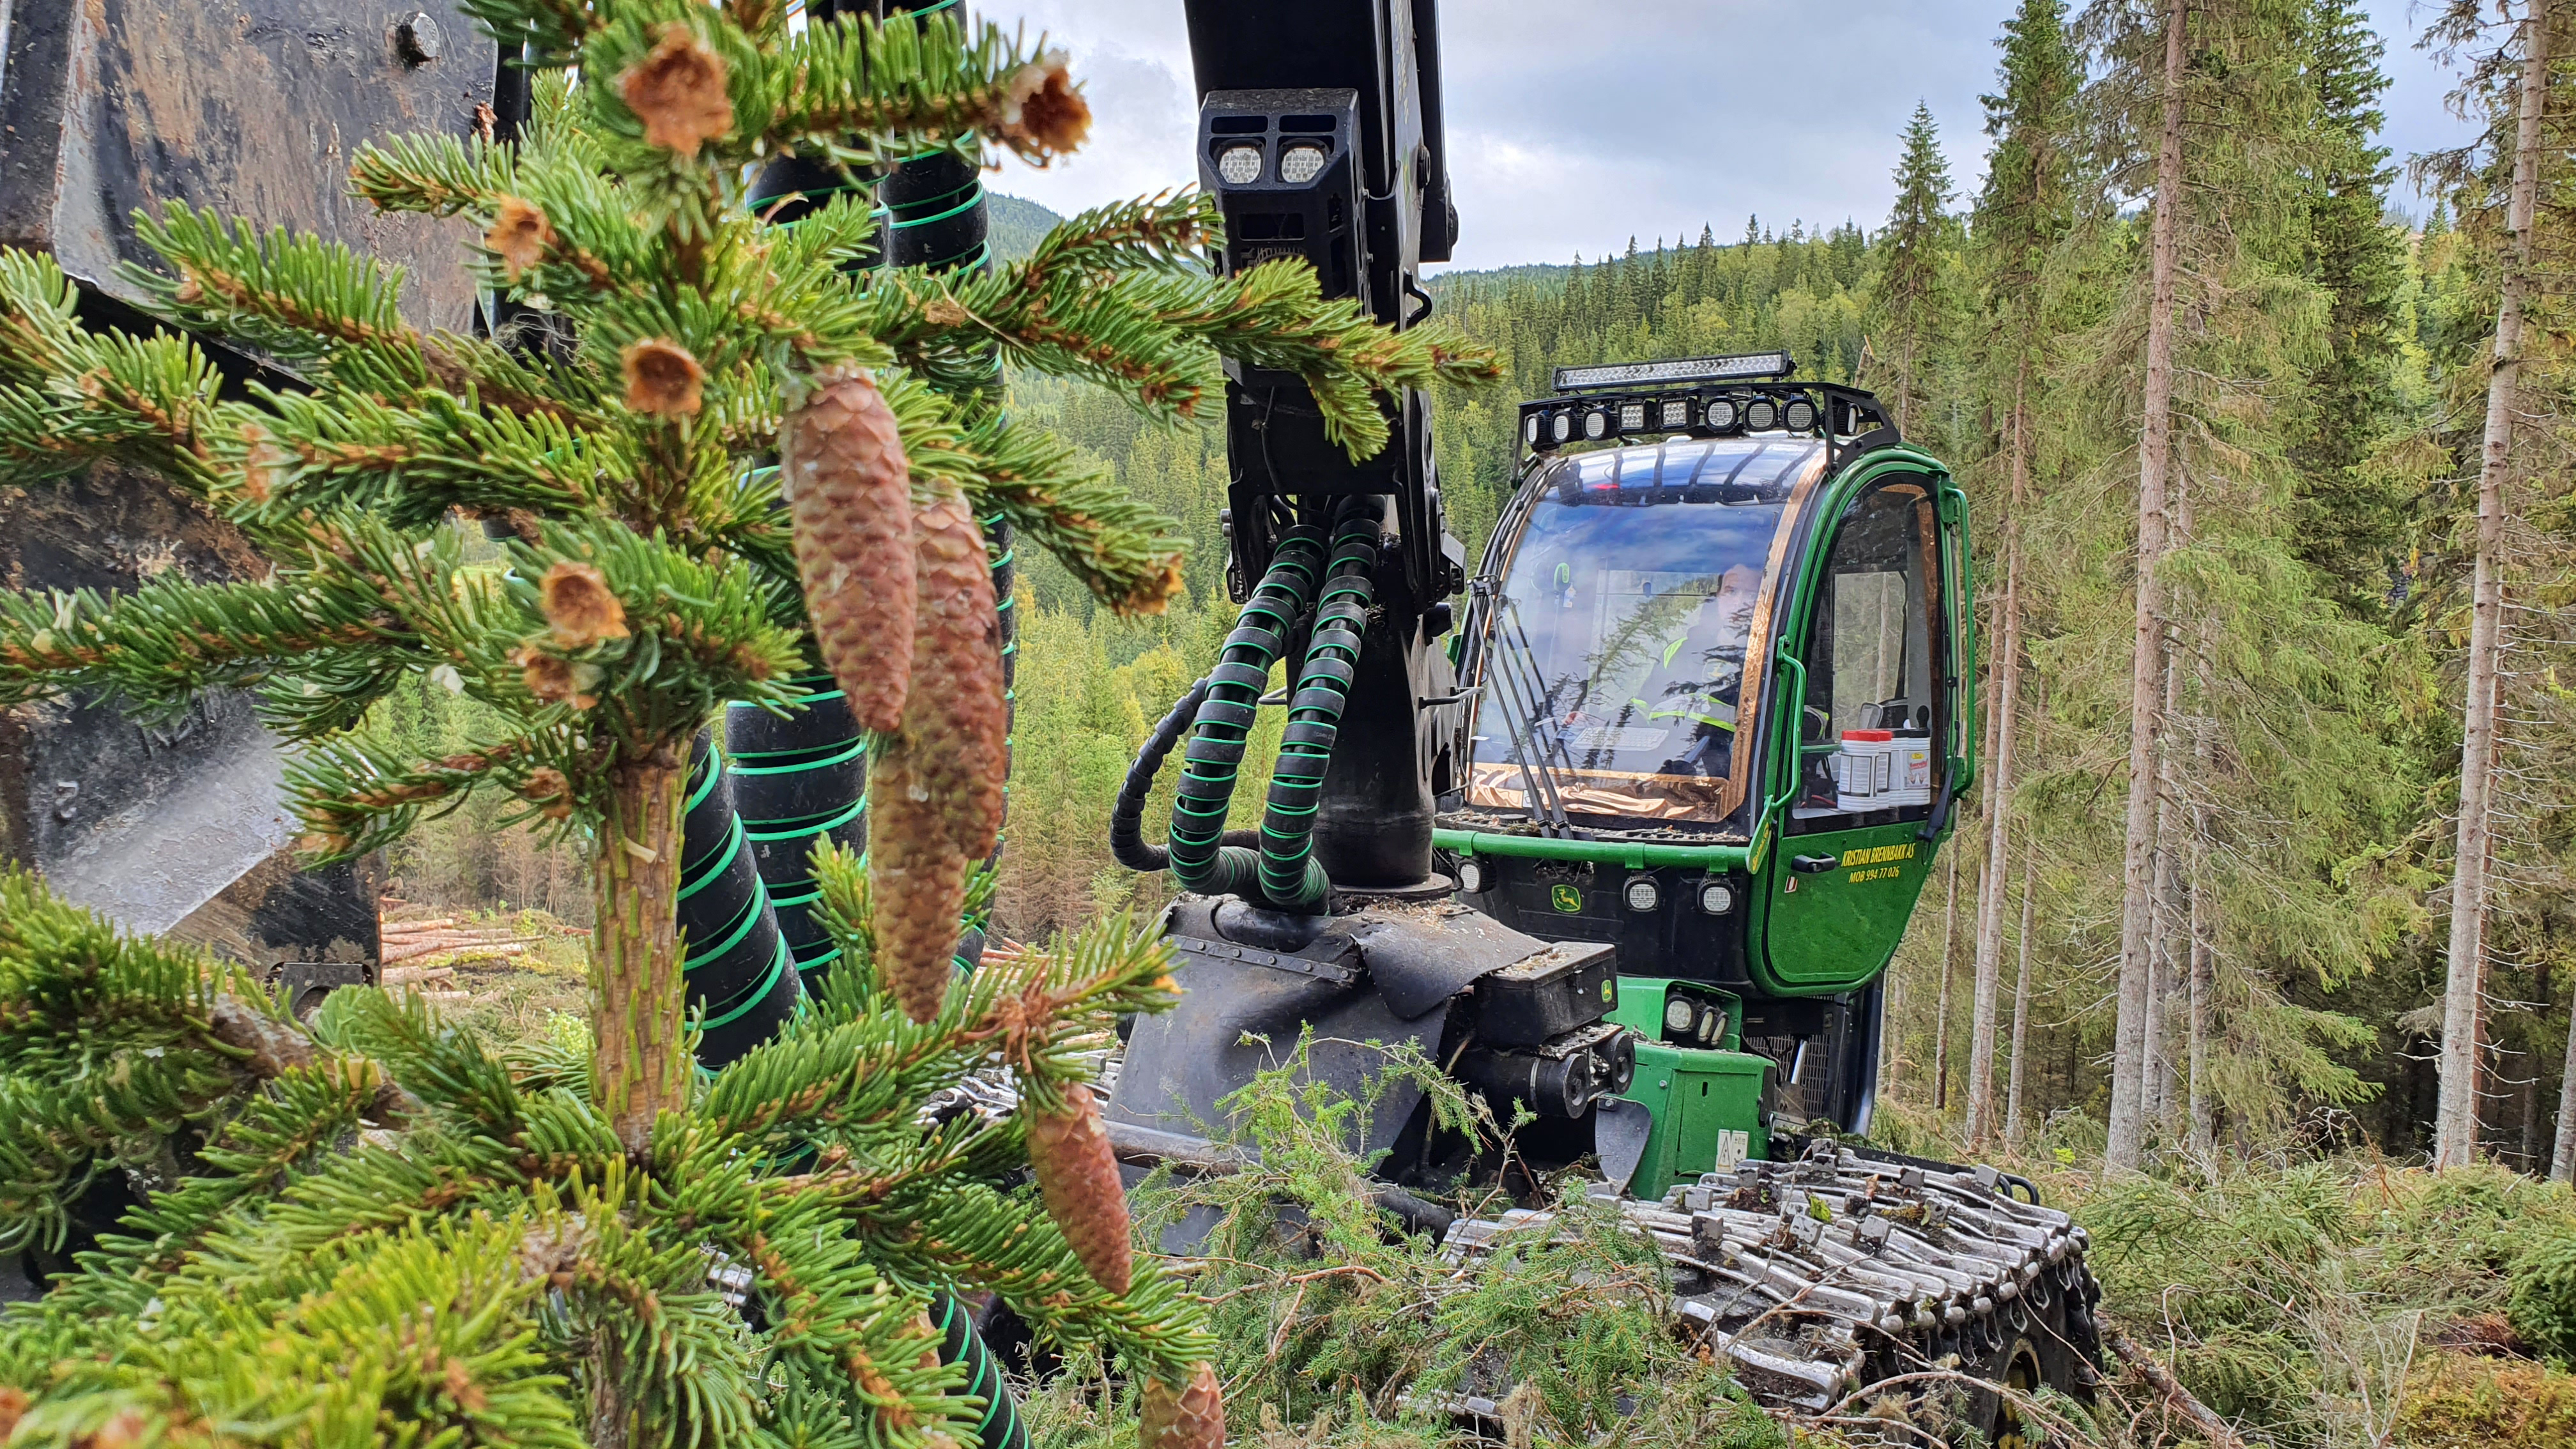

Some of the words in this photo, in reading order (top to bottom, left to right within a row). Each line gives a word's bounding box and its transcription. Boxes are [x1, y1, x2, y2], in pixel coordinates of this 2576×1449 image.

[1841, 848, 1871, 867] KRISTIAN
[1870, 844, 1908, 863] BRENNBAKK
[1905, 843, 1916, 859] AS
[1848, 870, 1866, 884] MOB
[1865, 869, 1878, 881] 994
[1878, 867, 1888, 878] 77
[1887, 866, 1900, 878] 026
